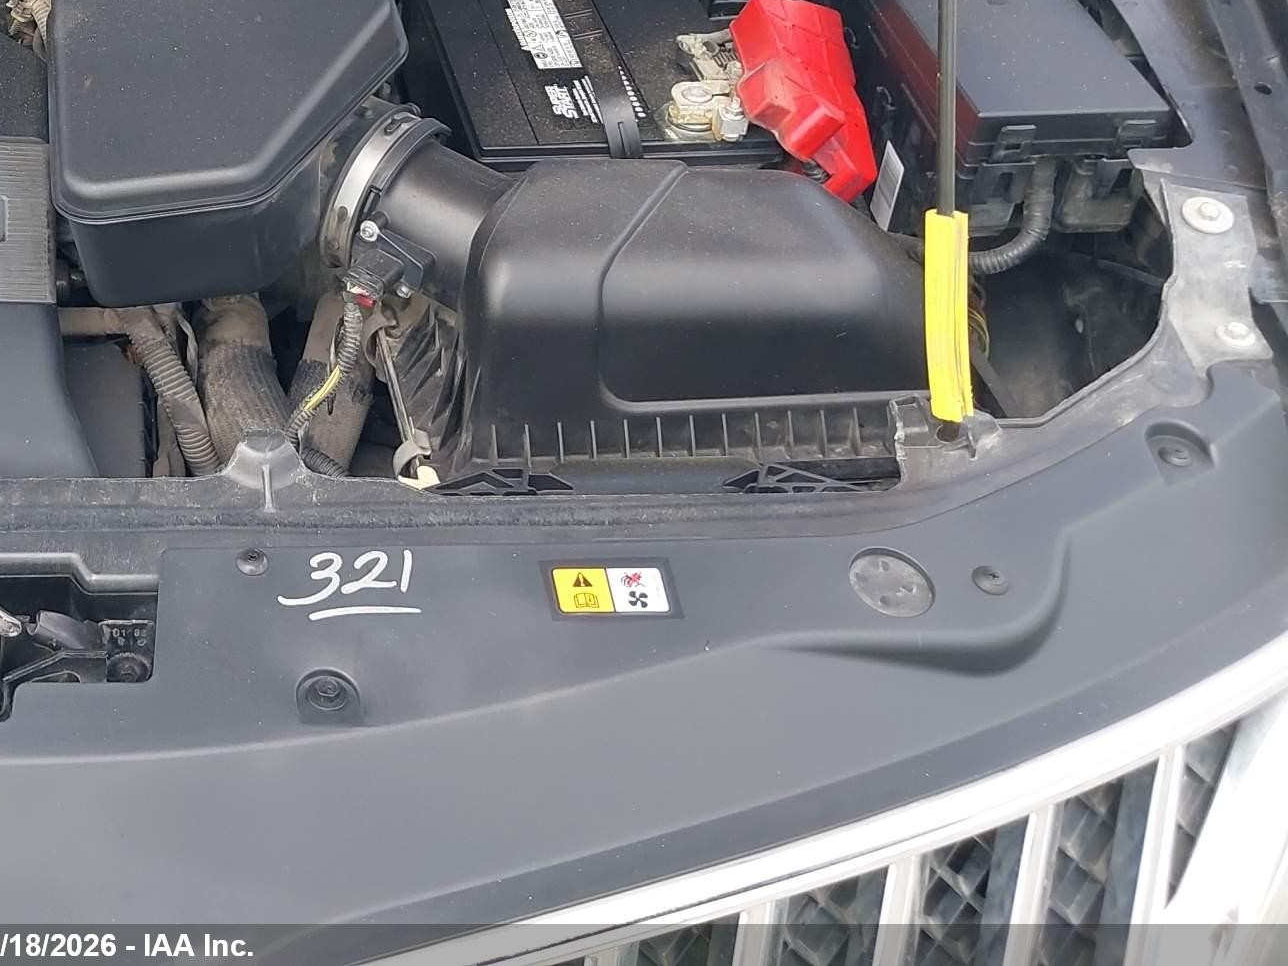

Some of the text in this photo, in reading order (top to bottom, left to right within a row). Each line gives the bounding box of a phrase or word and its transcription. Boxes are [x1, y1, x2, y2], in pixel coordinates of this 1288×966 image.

[544, 84, 562, 115] SUPER
[557, 85, 580, 119] START
[277, 549, 412, 606] 321
